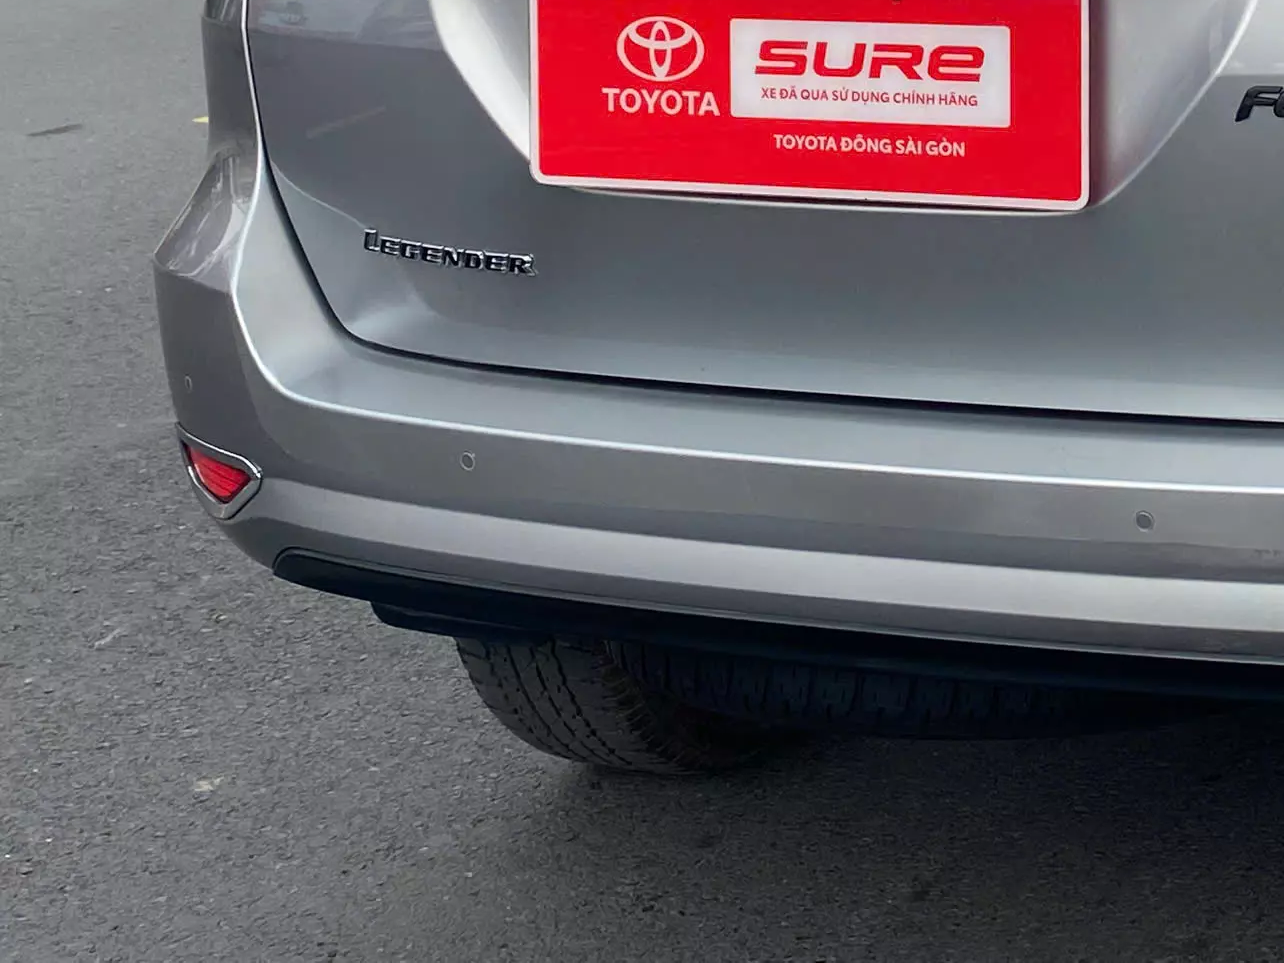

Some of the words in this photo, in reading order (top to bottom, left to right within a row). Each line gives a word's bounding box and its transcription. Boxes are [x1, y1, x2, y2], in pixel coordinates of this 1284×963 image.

[602, 86, 720, 117] TOYOTA
[761, 88, 777, 100] XE
[779, 86, 797, 100] ĐÃ
[800, 89, 829, 102] QUA
[832, 87, 849, 102] SỬ
[852, 91, 890, 106] DỤNG
[893, 90, 935, 105] CHÍNH
[938, 92, 978, 107] HÃNG
[773, 134, 837, 153] TOYOTA
[840, 134, 893, 155] ĐÔNG
[895, 136, 922, 155] SÀI
[925, 137, 966, 157] GÒN
[363, 228, 538, 277] LEGENDER
